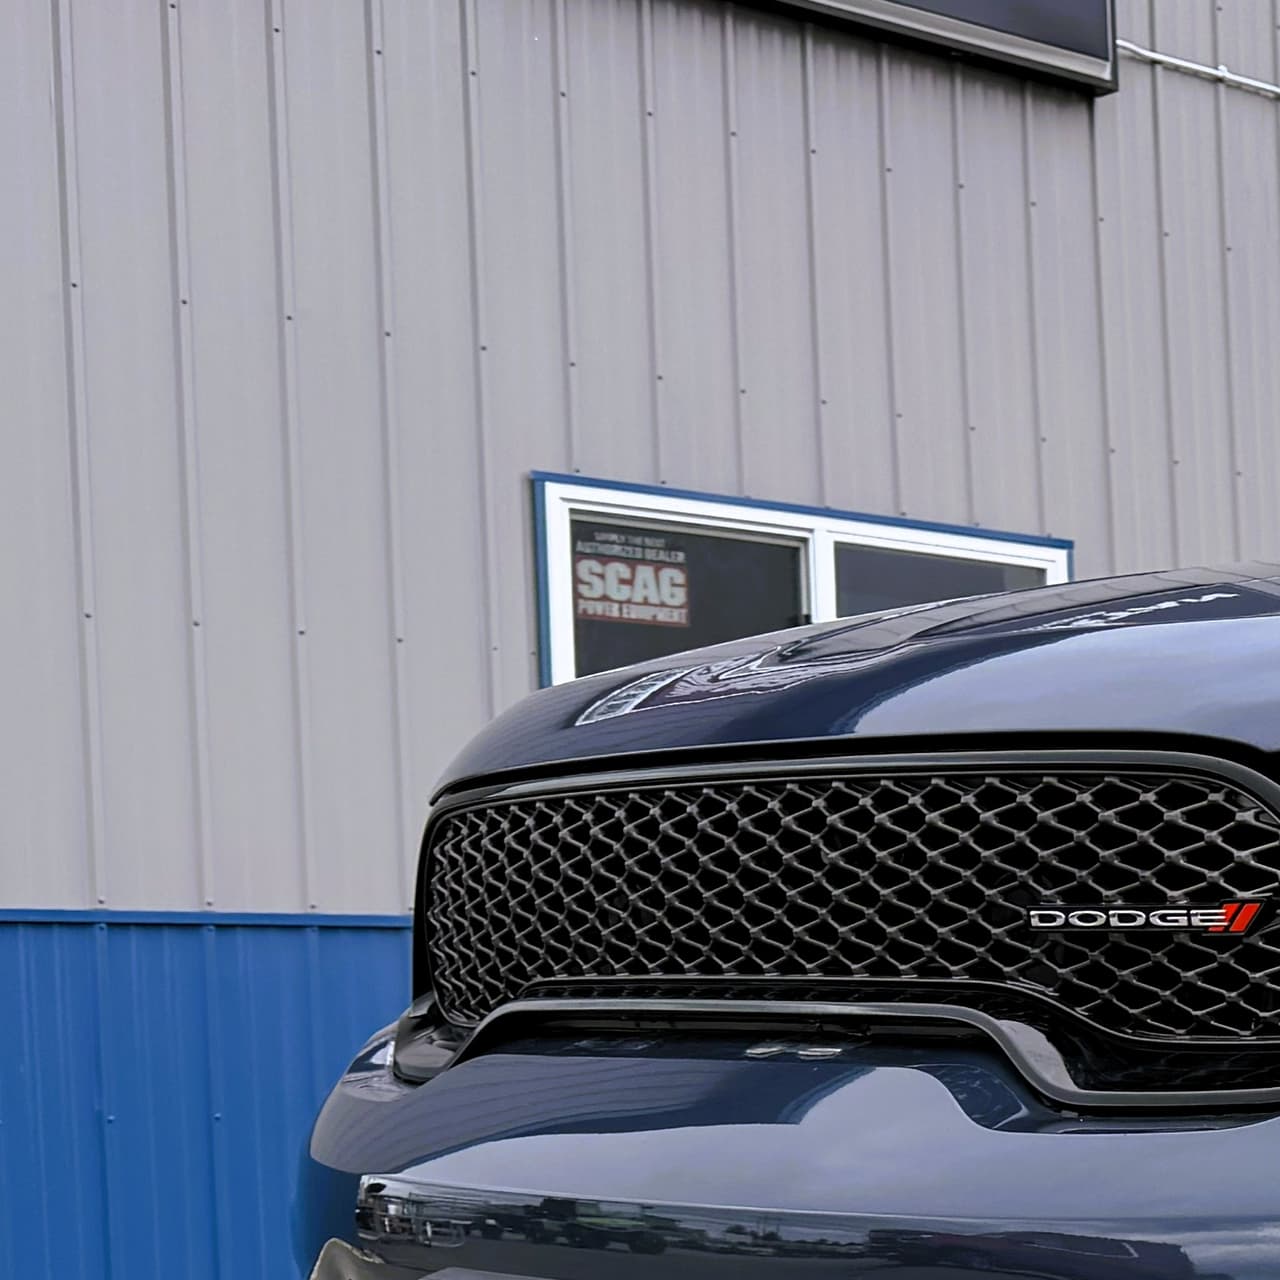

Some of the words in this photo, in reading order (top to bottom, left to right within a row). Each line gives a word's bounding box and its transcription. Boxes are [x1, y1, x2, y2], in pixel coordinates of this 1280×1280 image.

[644, 548, 685, 562] DEALER
[576, 559, 688, 606] SCAG
[577, 599, 620, 617] POWER
[1029, 909, 1230, 927] DODGE
